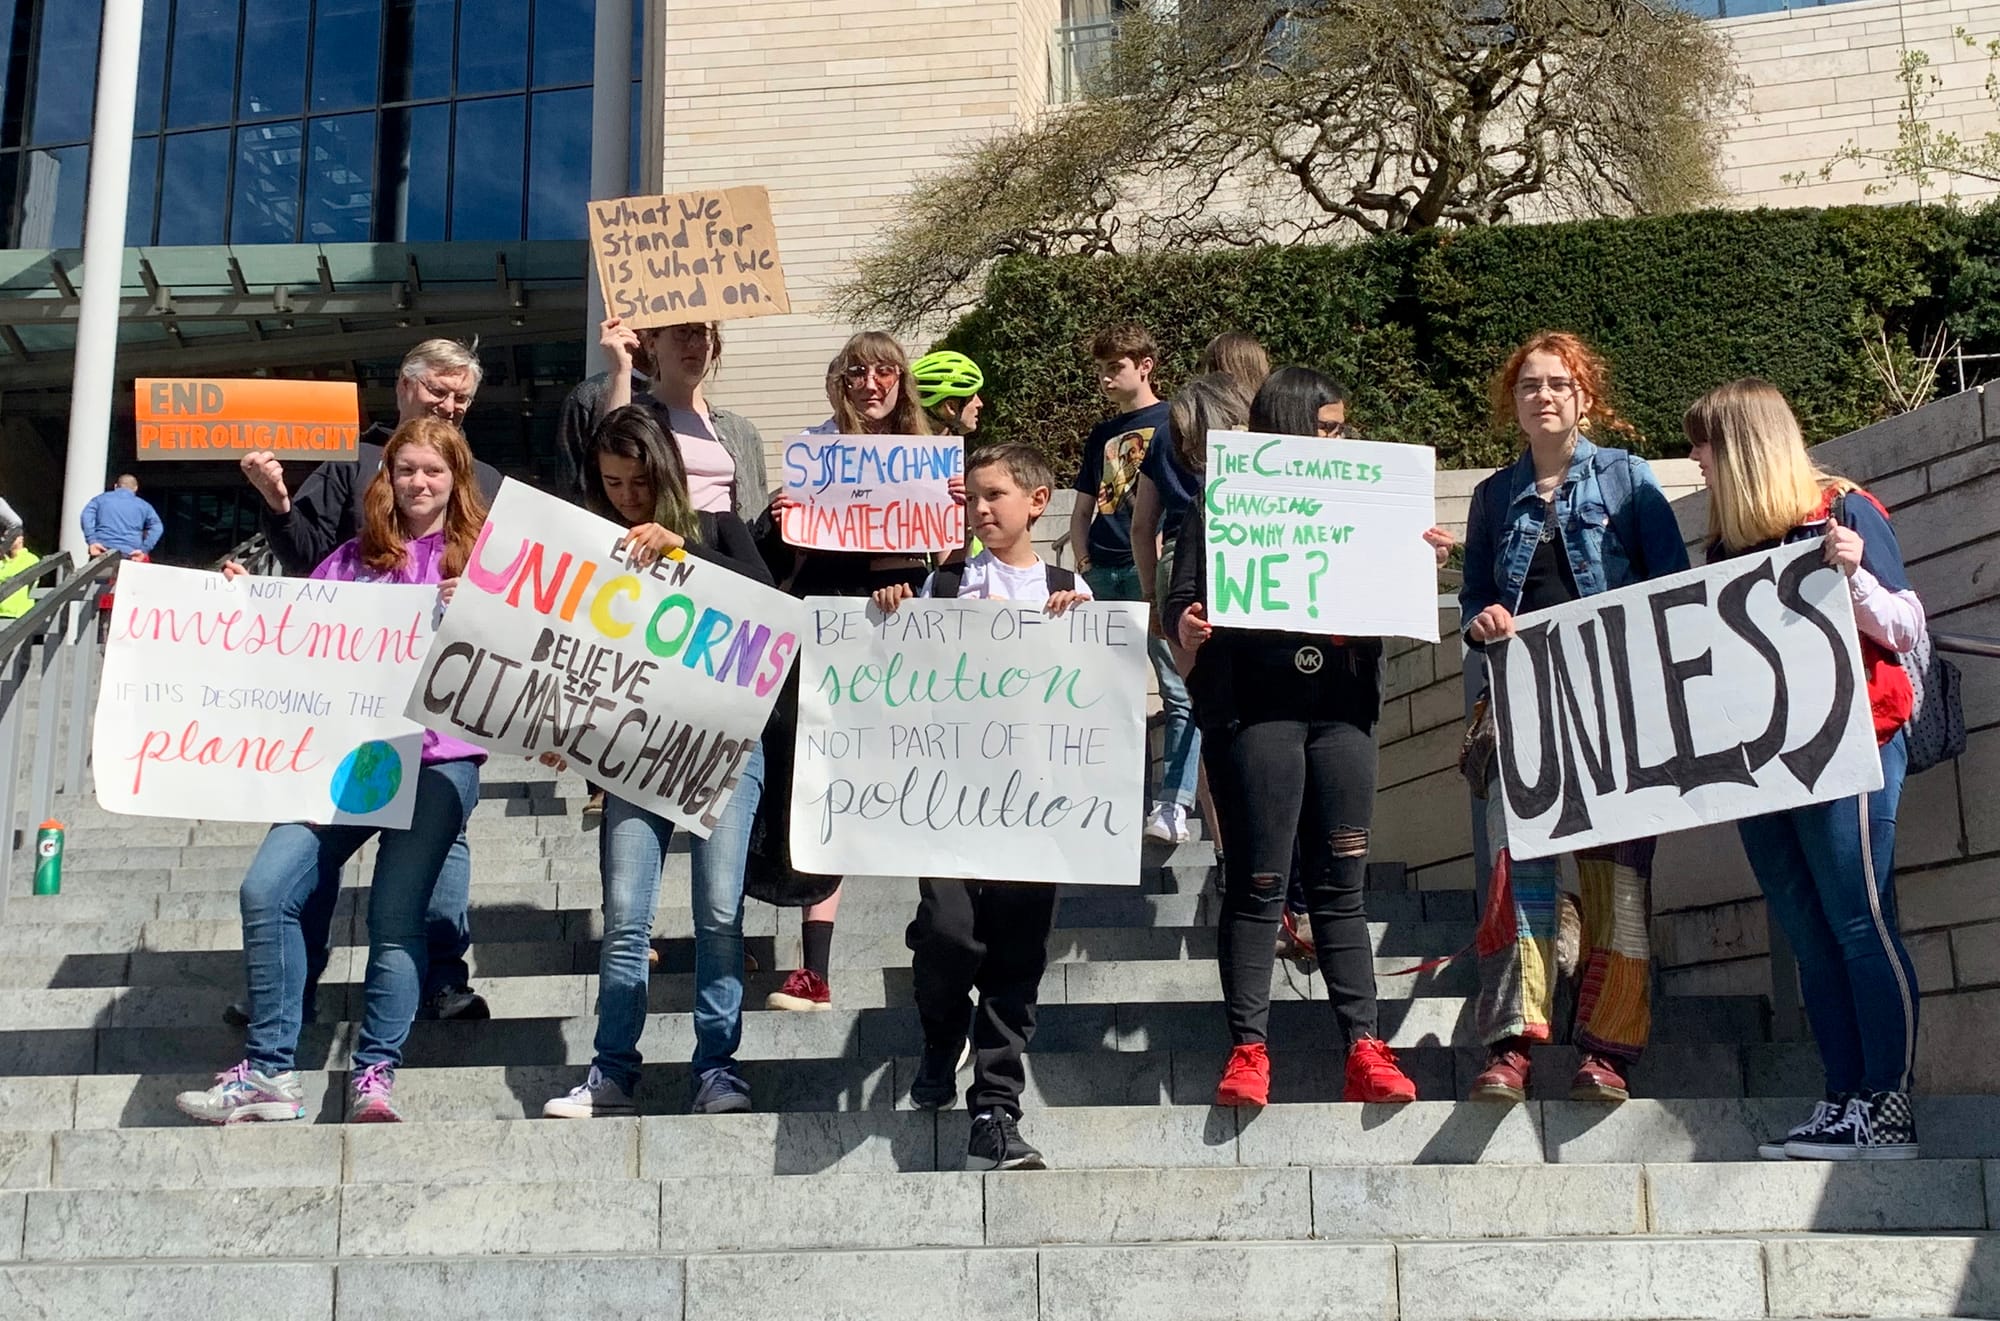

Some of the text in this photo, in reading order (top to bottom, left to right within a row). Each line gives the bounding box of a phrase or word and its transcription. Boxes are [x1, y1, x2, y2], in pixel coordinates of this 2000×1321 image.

[151, 382, 224, 415] END
[140, 423, 358, 450] PETROLIGARCHY
[851, 488, 872, 499] NOT
[1357, 463, 1383, 484] IS
[1206, 477, 1323, 517] CHANGING
[1208, 517, 1248, 547] SO
[1250, 522, 1286, 548] WHY
[249, 580, 289, 599] NOT
[296, 582, 338, 604] AN
[467, 520, 797, 698] UNICORNS
[117, 603, 424, 664] investment
[813, 608, 1129, 647] BE PART OF THE
[531, 627, 660, 704] BELIEVE
[563, 673, 598, 697] IN
[816, 652, 1105, 709] solution
[116, 682, 386, 719] IF IT'S DESTROYING THE
[1485, 546, 1855, 839] UNLESS
[423, 641, 758, 828] CLIMATE CHANGE
[808, 720, 1111, 766] NOT PART OF THE
[124, 719, 325, 795] planet
[809, 766, 1130, 845] pollution
